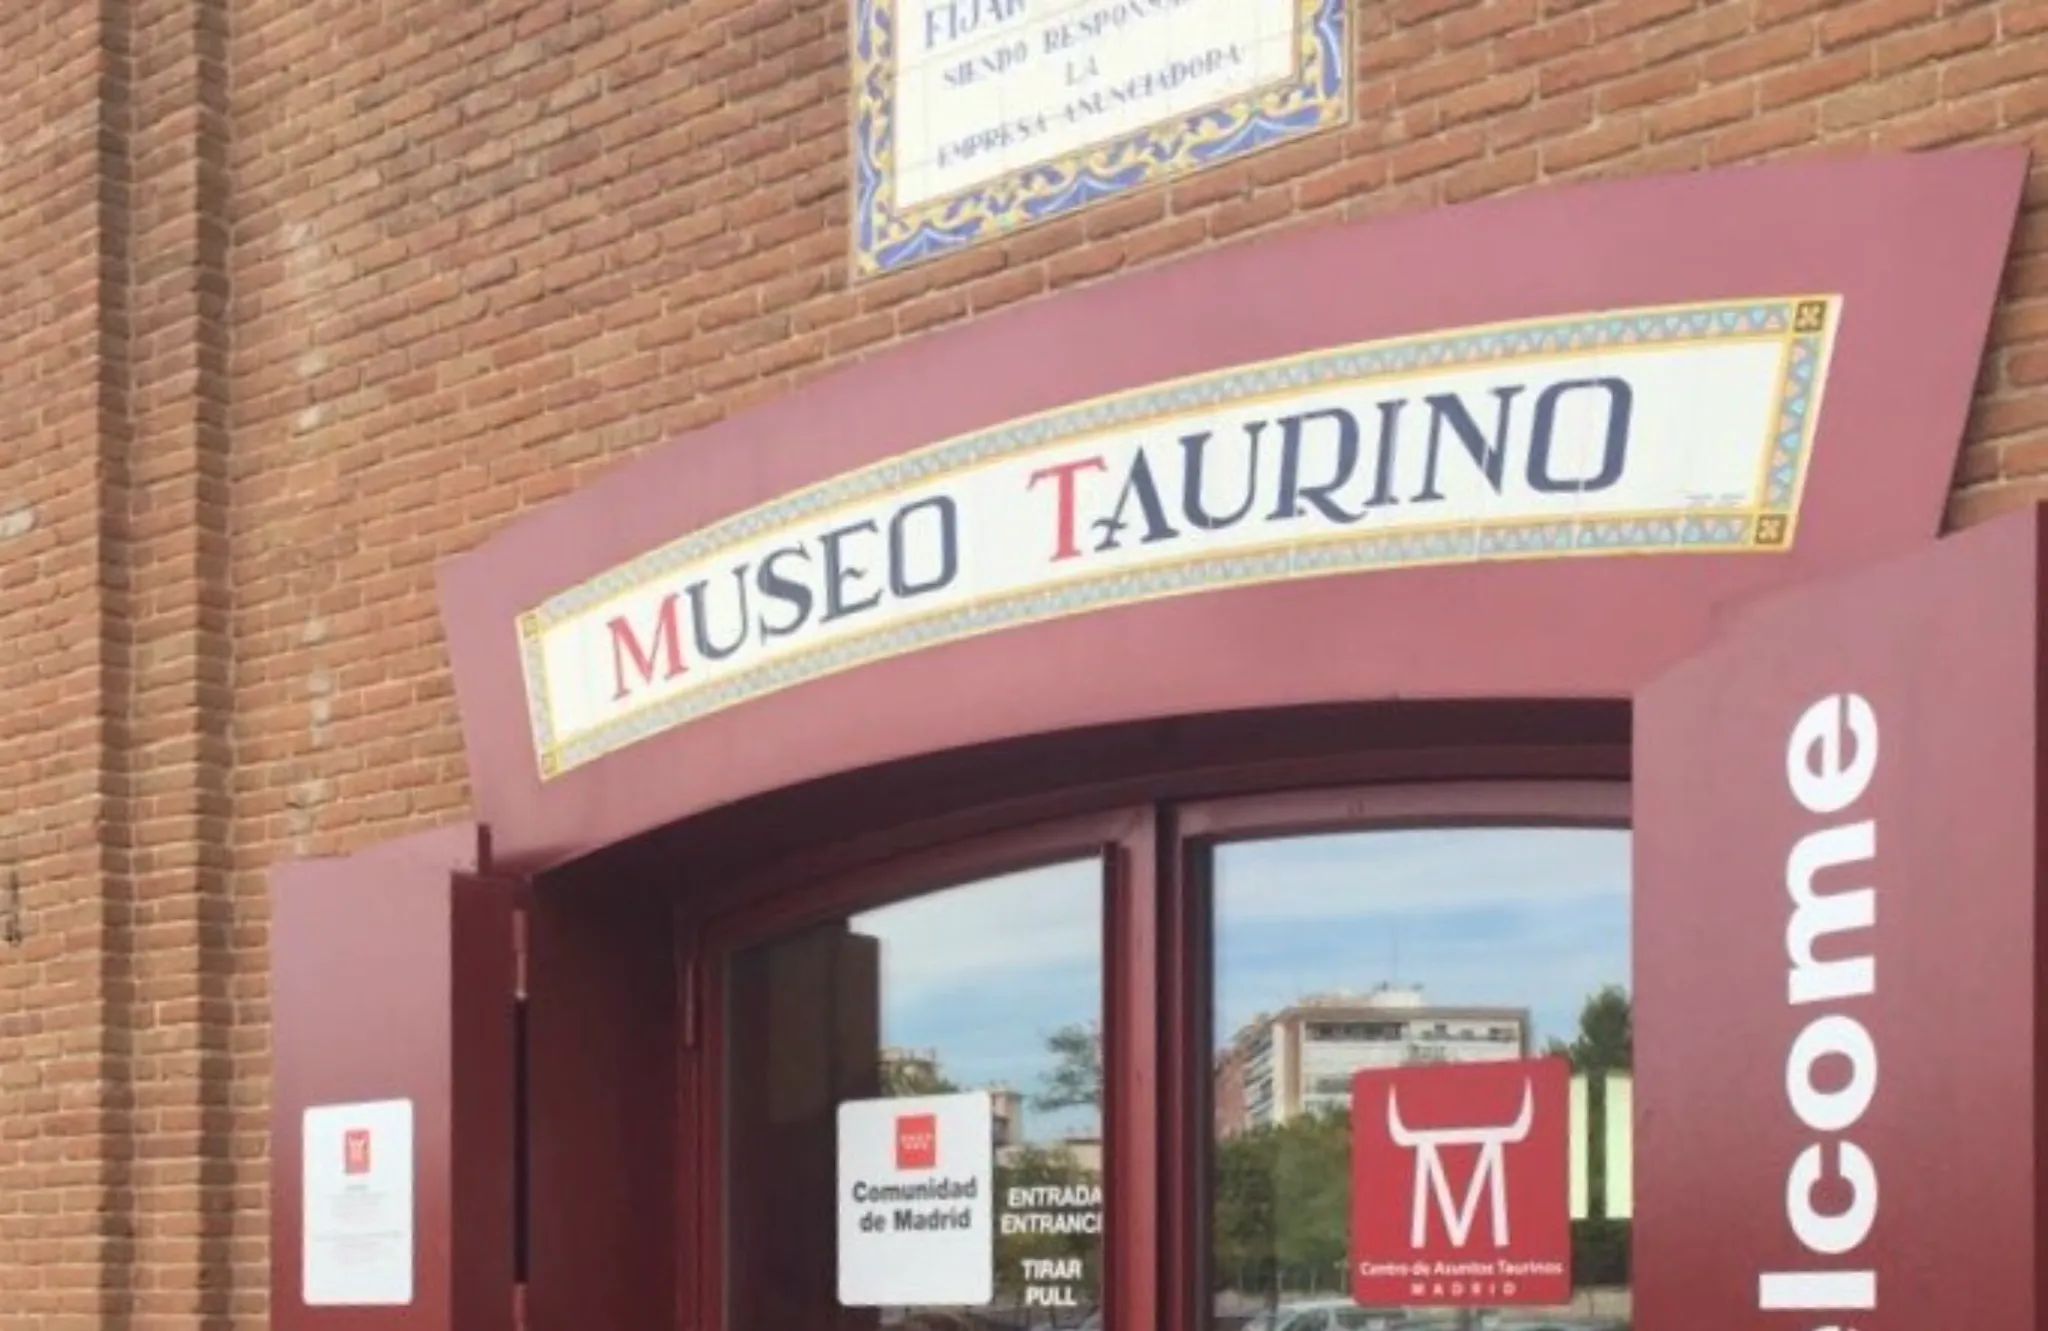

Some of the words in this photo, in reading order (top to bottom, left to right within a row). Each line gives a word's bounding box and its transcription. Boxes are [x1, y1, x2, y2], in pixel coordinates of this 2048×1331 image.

[944, 41, 1028, 86] SIENDO
[1065, 55, 1099, 86] LA
[938, 112, 1048, 167] EMPRESA
[606, 494, 957, 701] MUSEO
[1026, 376, 1633, 563] TAURINO
[1758, 692, 1879, 1331] lcome
[853, 1176, 978, 1203] Comunidad
[1008, 1184, 1102, 1207] ENTRADA
[859, 1211, 887, 1233] de
[893, 1209, 972, 1231] Madrid
[1021, 1258, 1083, 1280] TIRAR
[1360, 1262, 1408, 1276] Centro
[1411, 1261, 1430, 1277] de
[1434, 1260, 1494, 1276] Asuntos
[1498, 1259, 1564, 1275] Taurinos
[1025, 1285, 1078, 1306] PULL
[1411, 1281, 1517, 1297] MADRID
